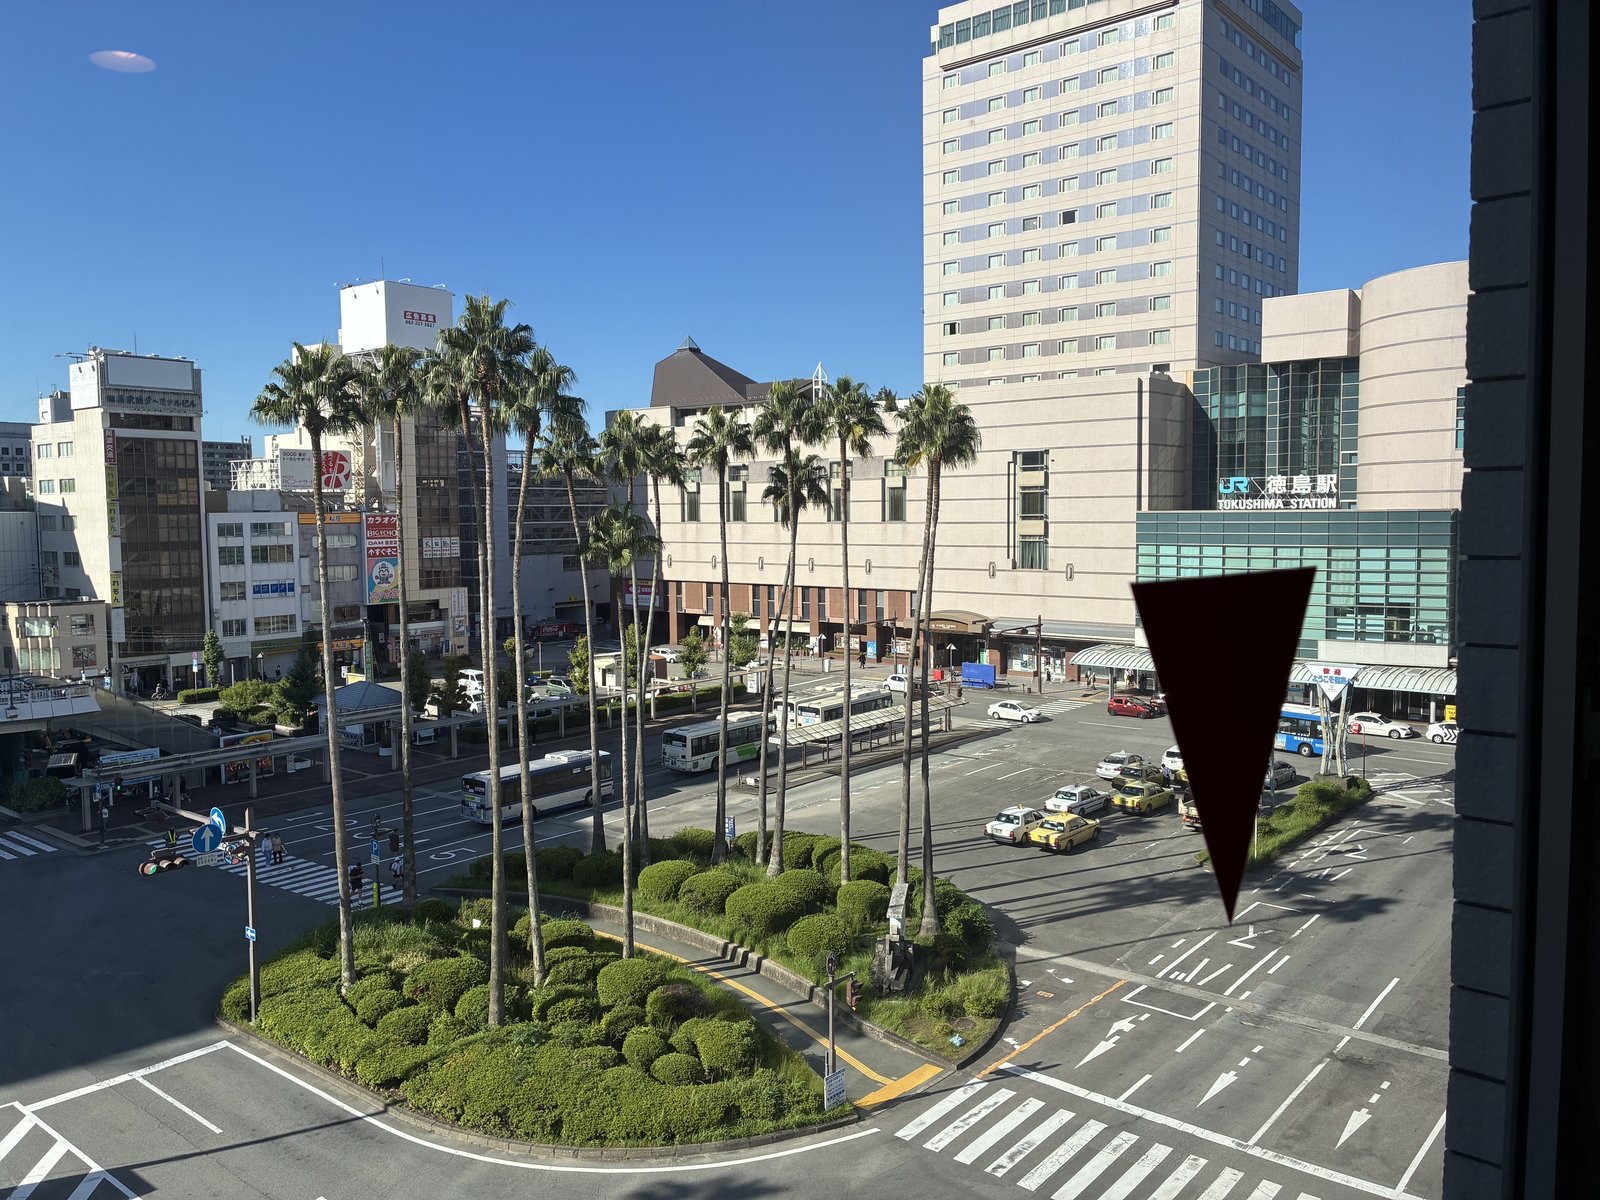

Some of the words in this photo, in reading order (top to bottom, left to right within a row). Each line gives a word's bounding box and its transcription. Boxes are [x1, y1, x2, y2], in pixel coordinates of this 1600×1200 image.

[1219, 476, 1249, 493] JR
[1267, 474, 1337, 494] 徳島駅
[1218, 498, 1284, 510] TOKUSHIMA
[1290, 497, 1336, 509] STATION
[367, 516, 397, 524] カラオケ
[374, 548, 398, 556] すぐそこ
[112, 580, 120, 603] れもん
